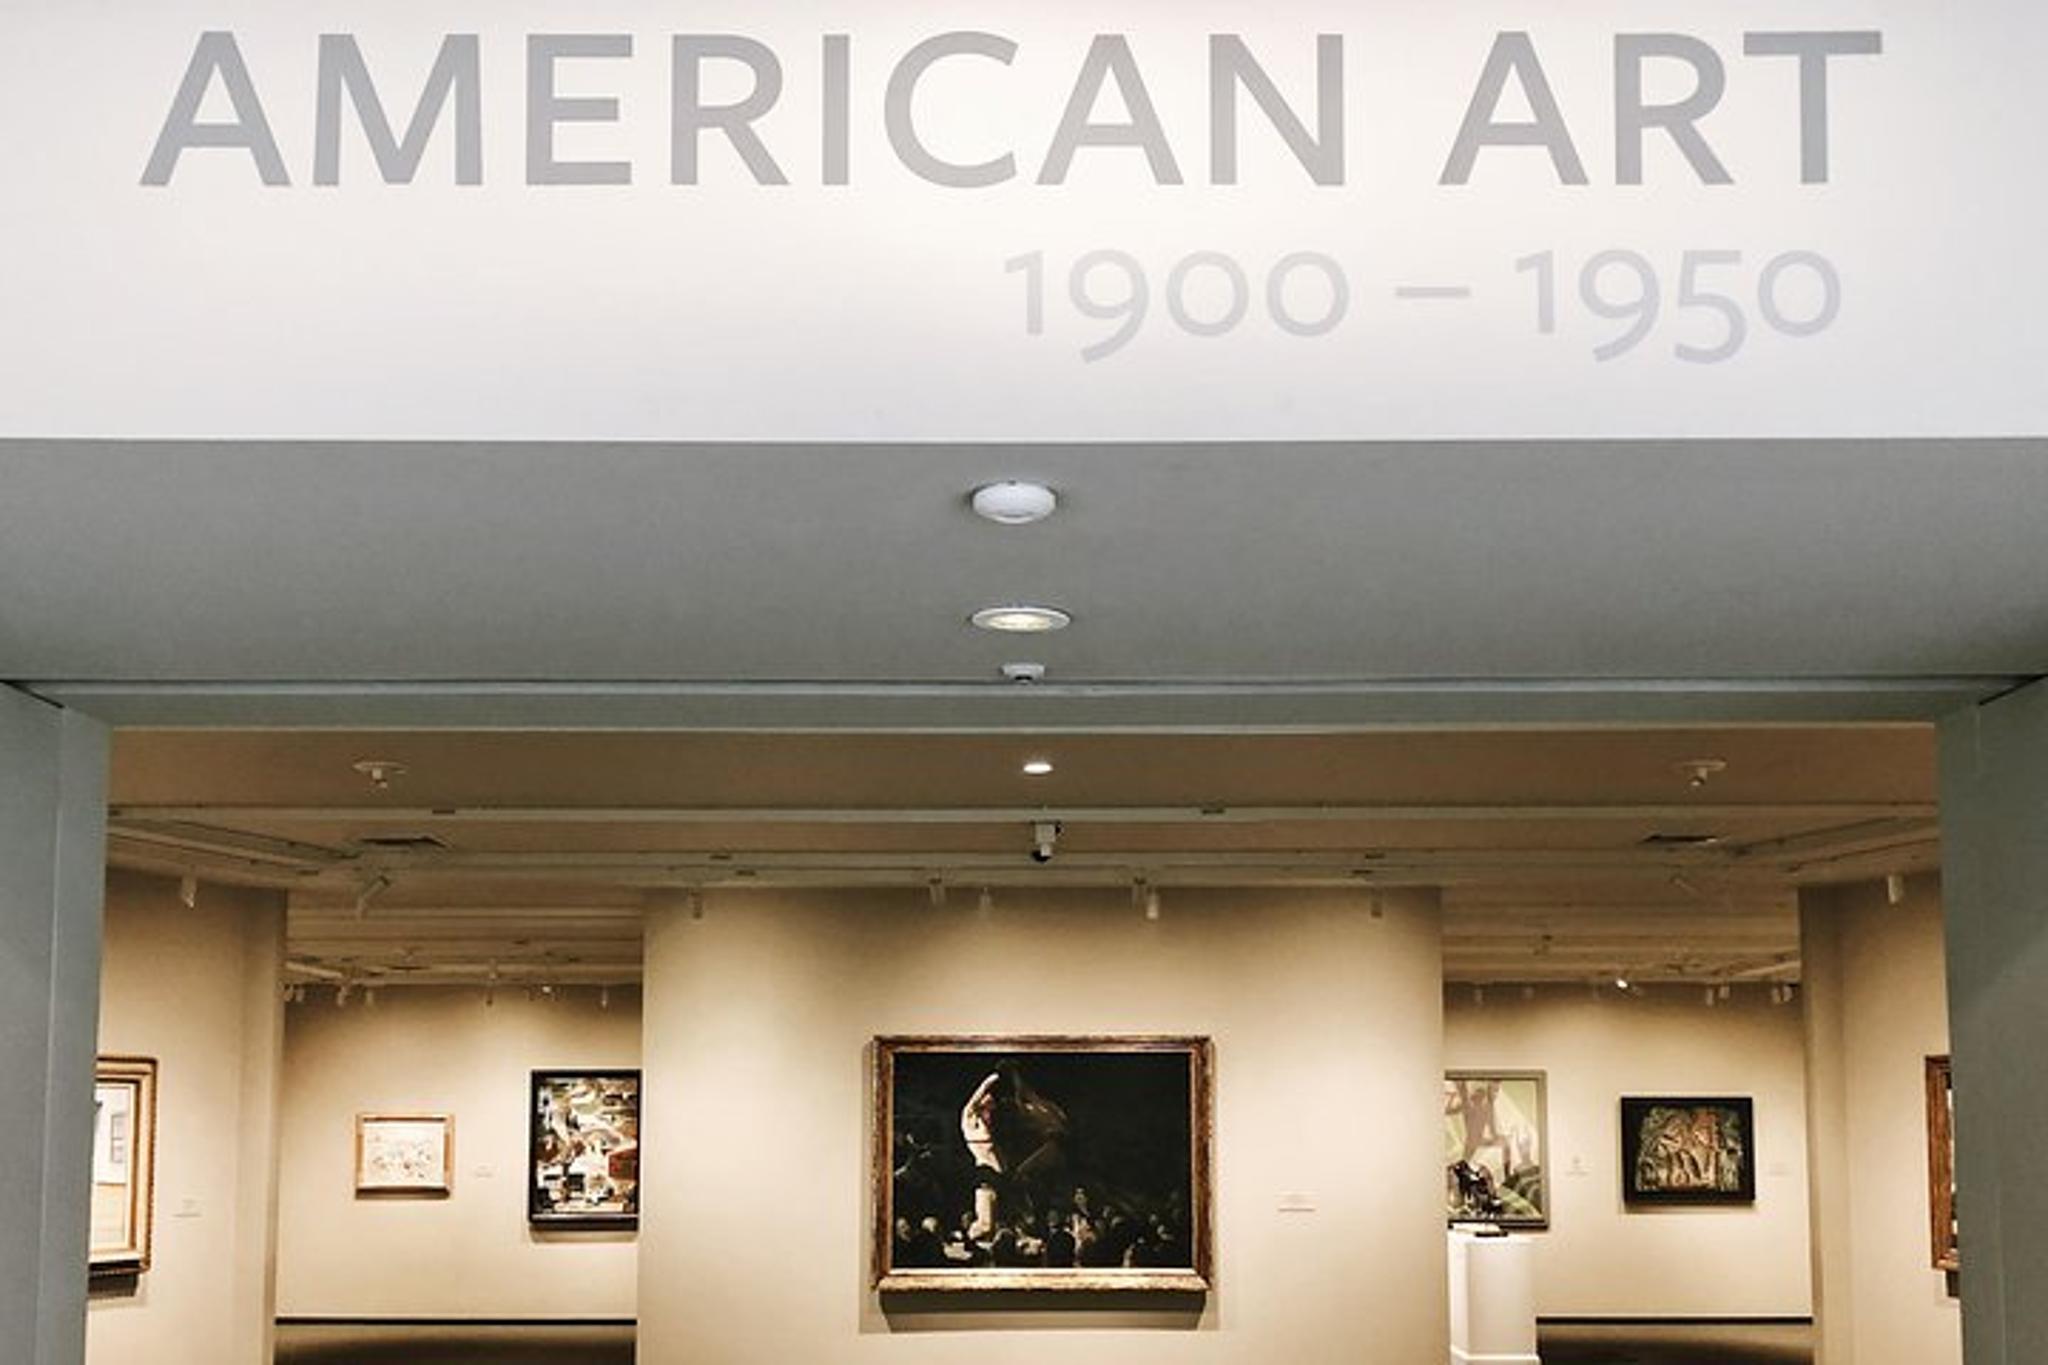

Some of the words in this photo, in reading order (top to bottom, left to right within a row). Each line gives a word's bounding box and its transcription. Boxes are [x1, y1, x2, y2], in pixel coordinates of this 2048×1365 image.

[138, 30, 1346, 189] AMERICAN
[1437, 30, 1884, 187] ART
[1005, 249, 1350, 364] 1900
[1515, 249, 1842, 365] 1950
